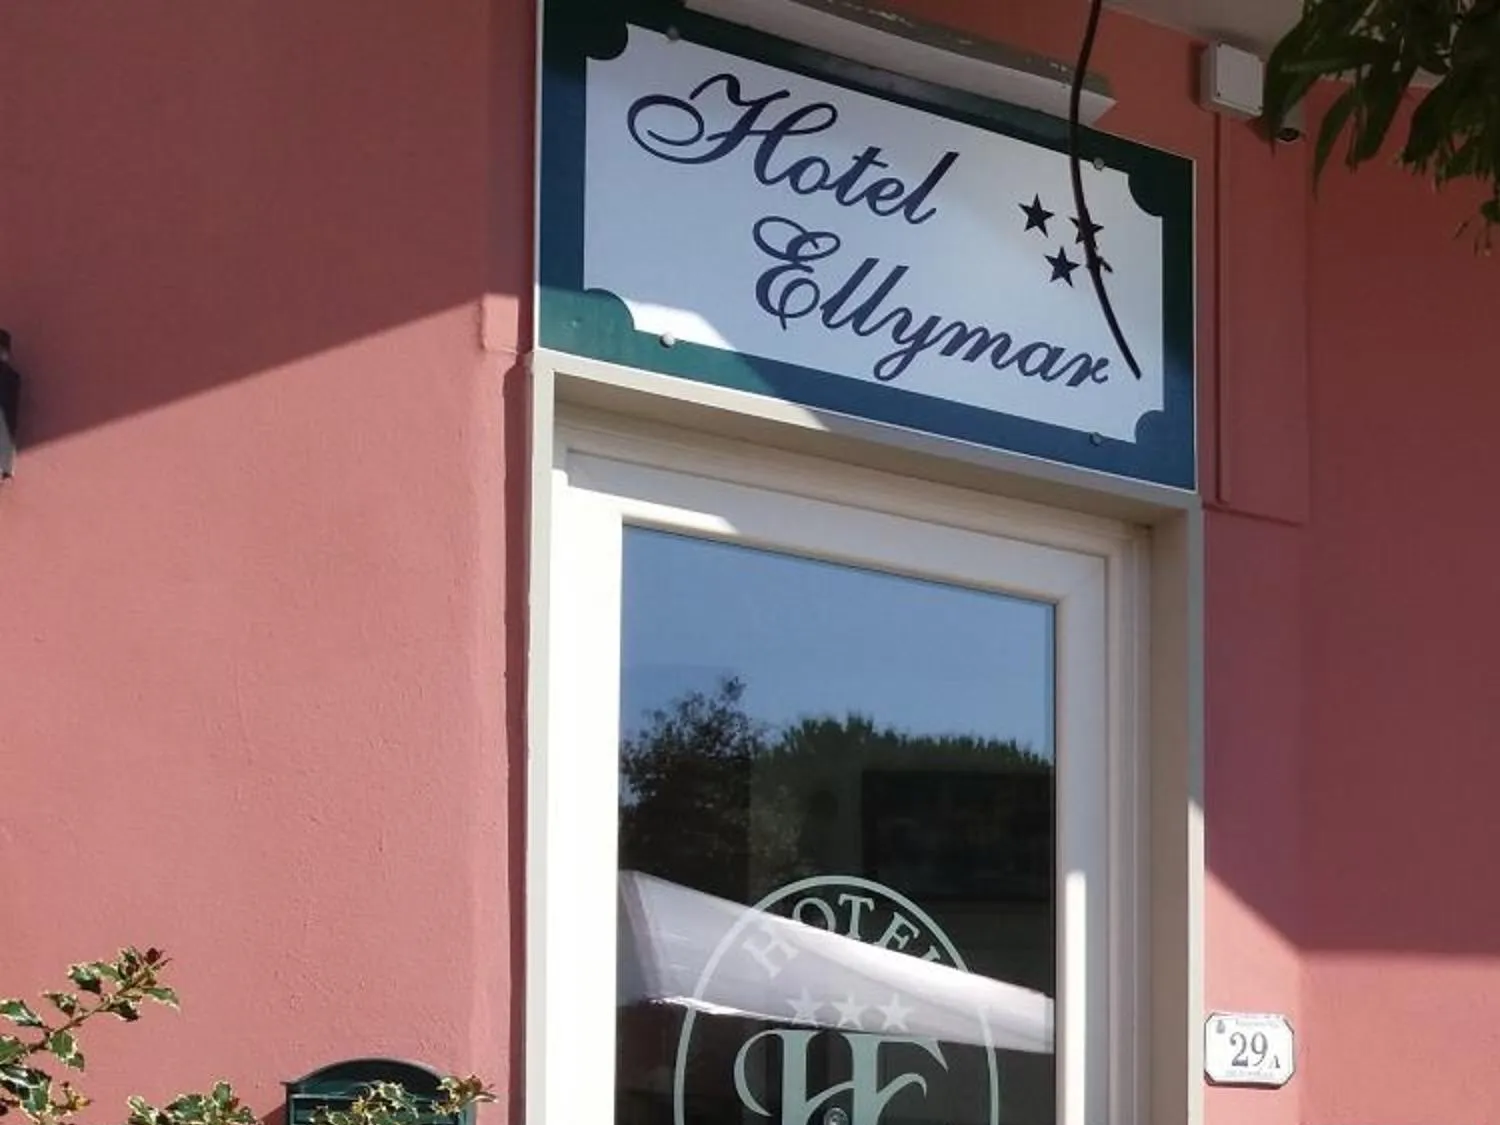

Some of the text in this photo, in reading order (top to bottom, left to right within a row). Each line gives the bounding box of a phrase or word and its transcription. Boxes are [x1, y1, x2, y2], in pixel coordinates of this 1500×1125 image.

[627, 73, 959, 224] Hotel
[753, 216, 1108, 387] Ellymar
[742, 893, 941, 979] HOTE
